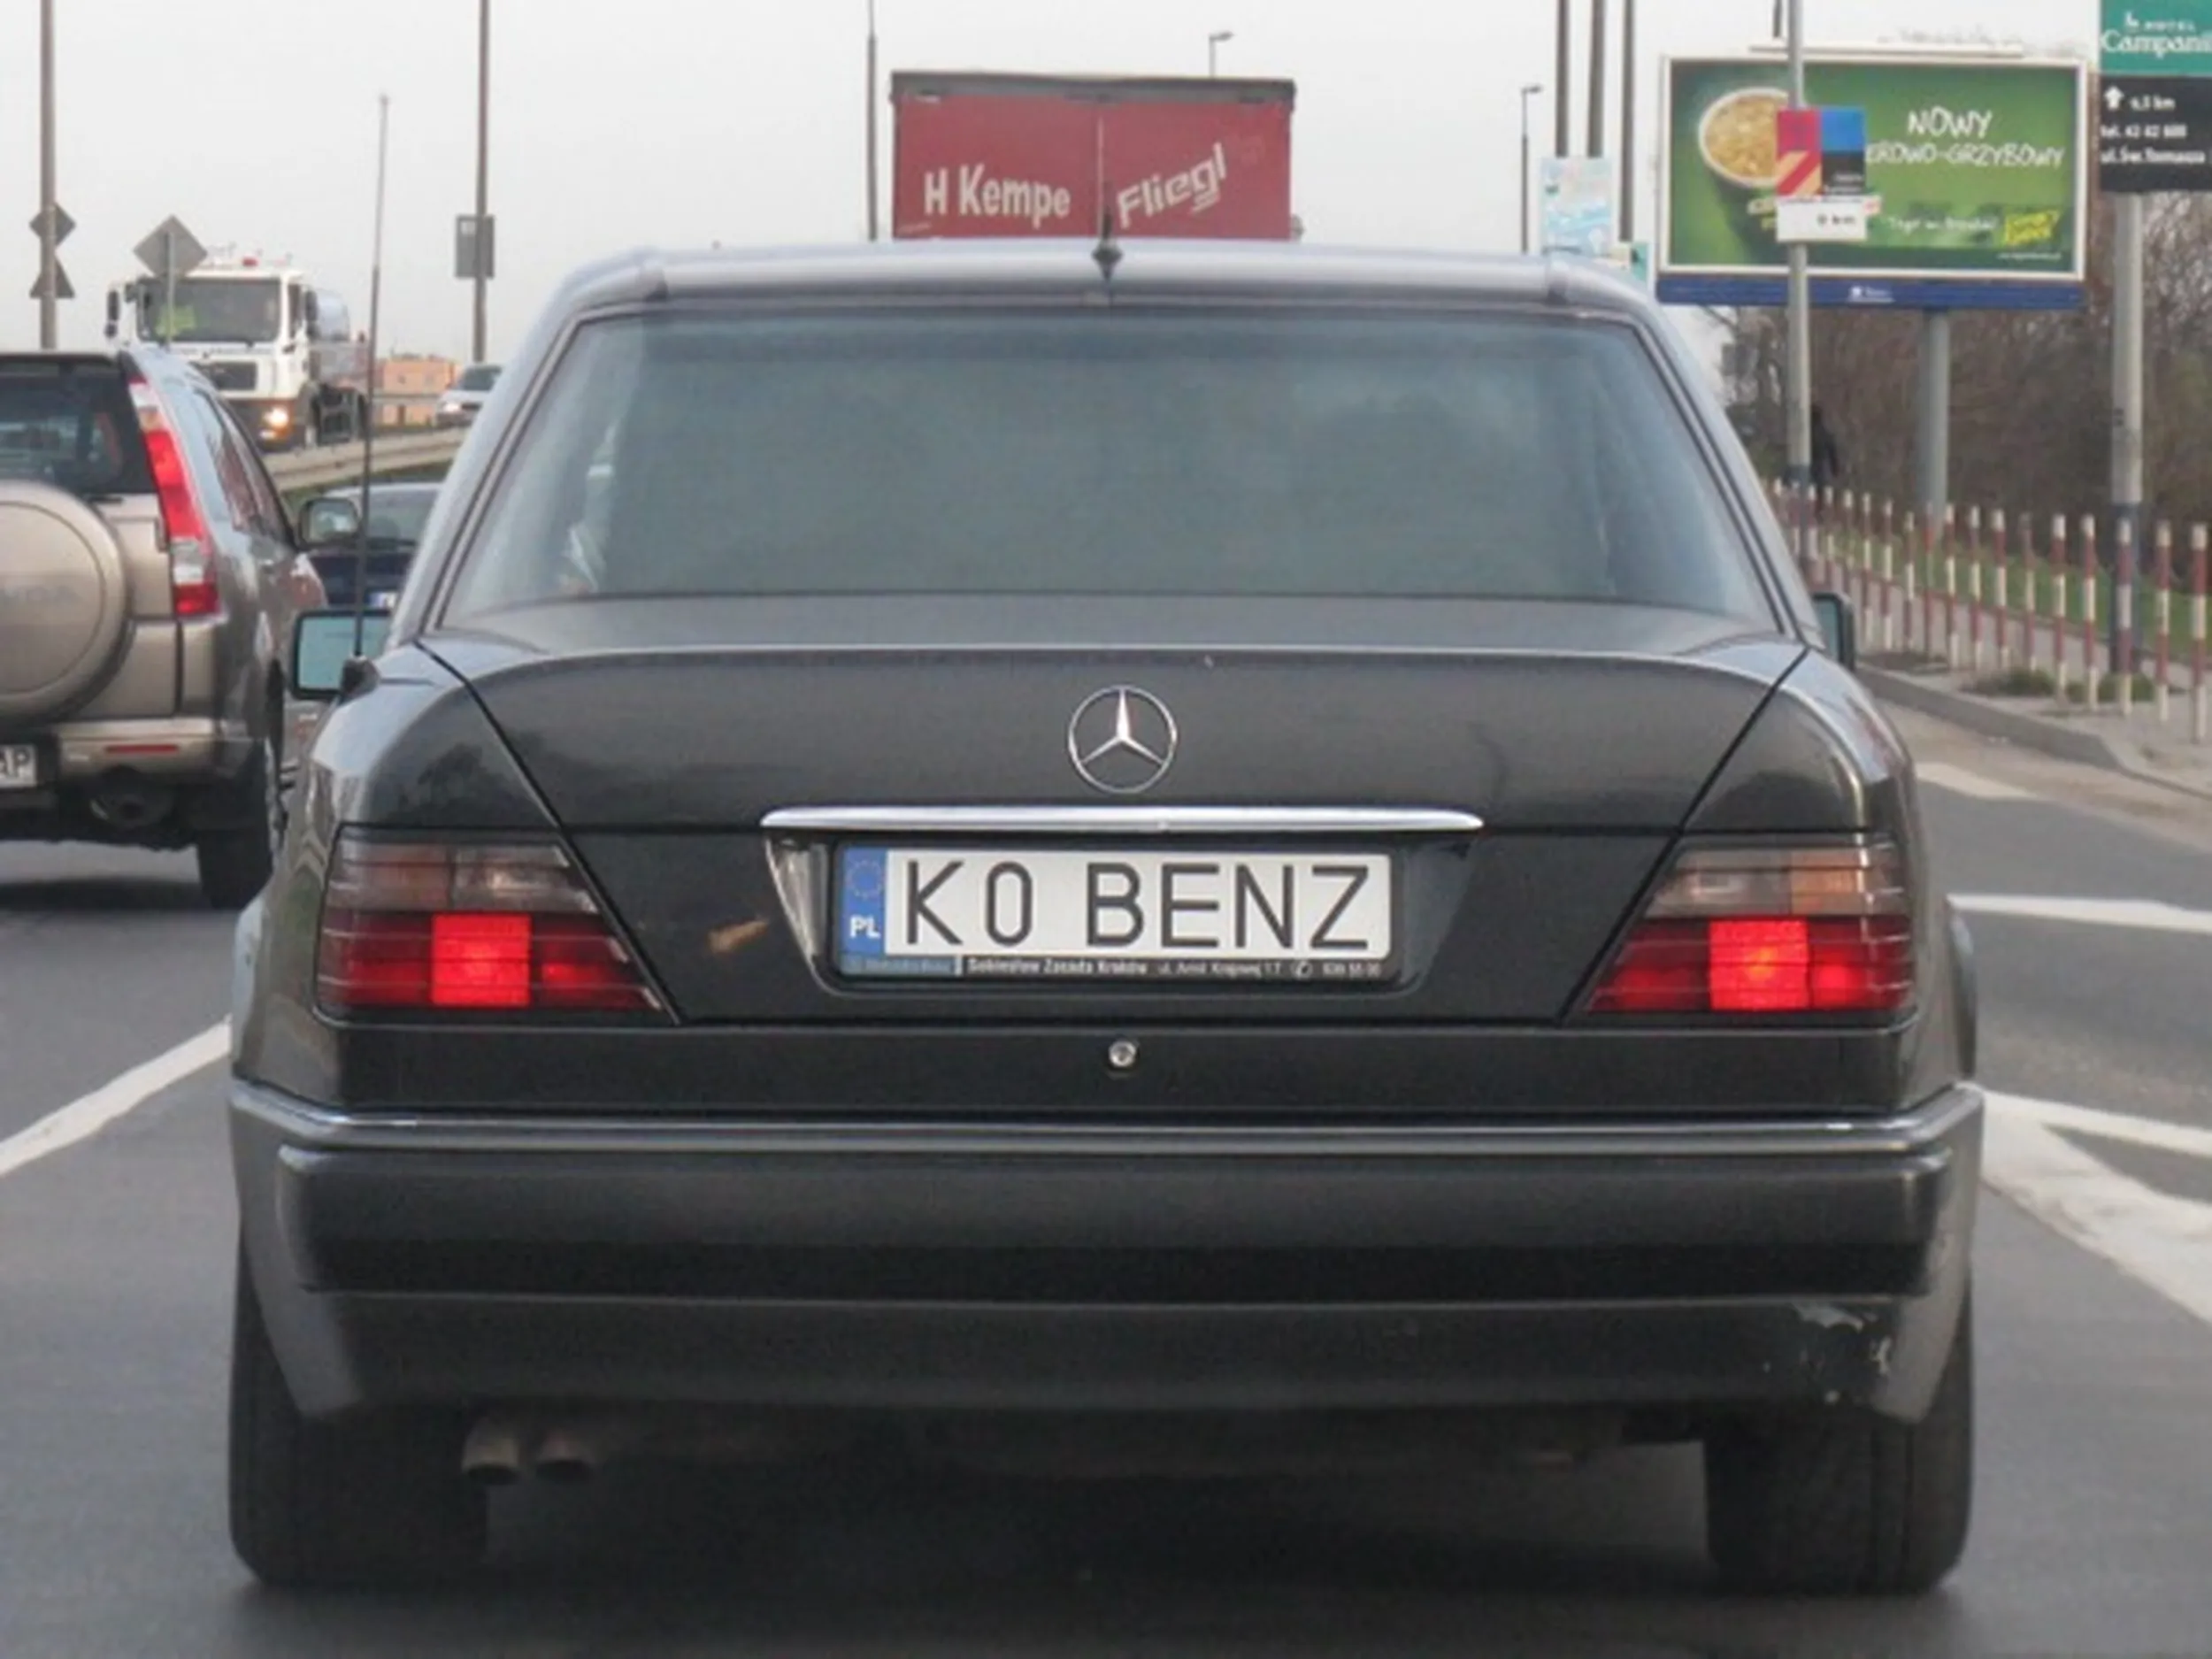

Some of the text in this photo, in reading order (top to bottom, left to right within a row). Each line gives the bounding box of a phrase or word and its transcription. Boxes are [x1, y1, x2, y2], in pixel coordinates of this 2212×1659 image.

[1908, 105, 1993, 139] NOWY
[924, 164, 1071, 230] H Kempe
[1118, 142, 1227, 229] Fliegl
[849, 915, 880, 938] PL
[1086, 862, 1371, 950] BENZ
